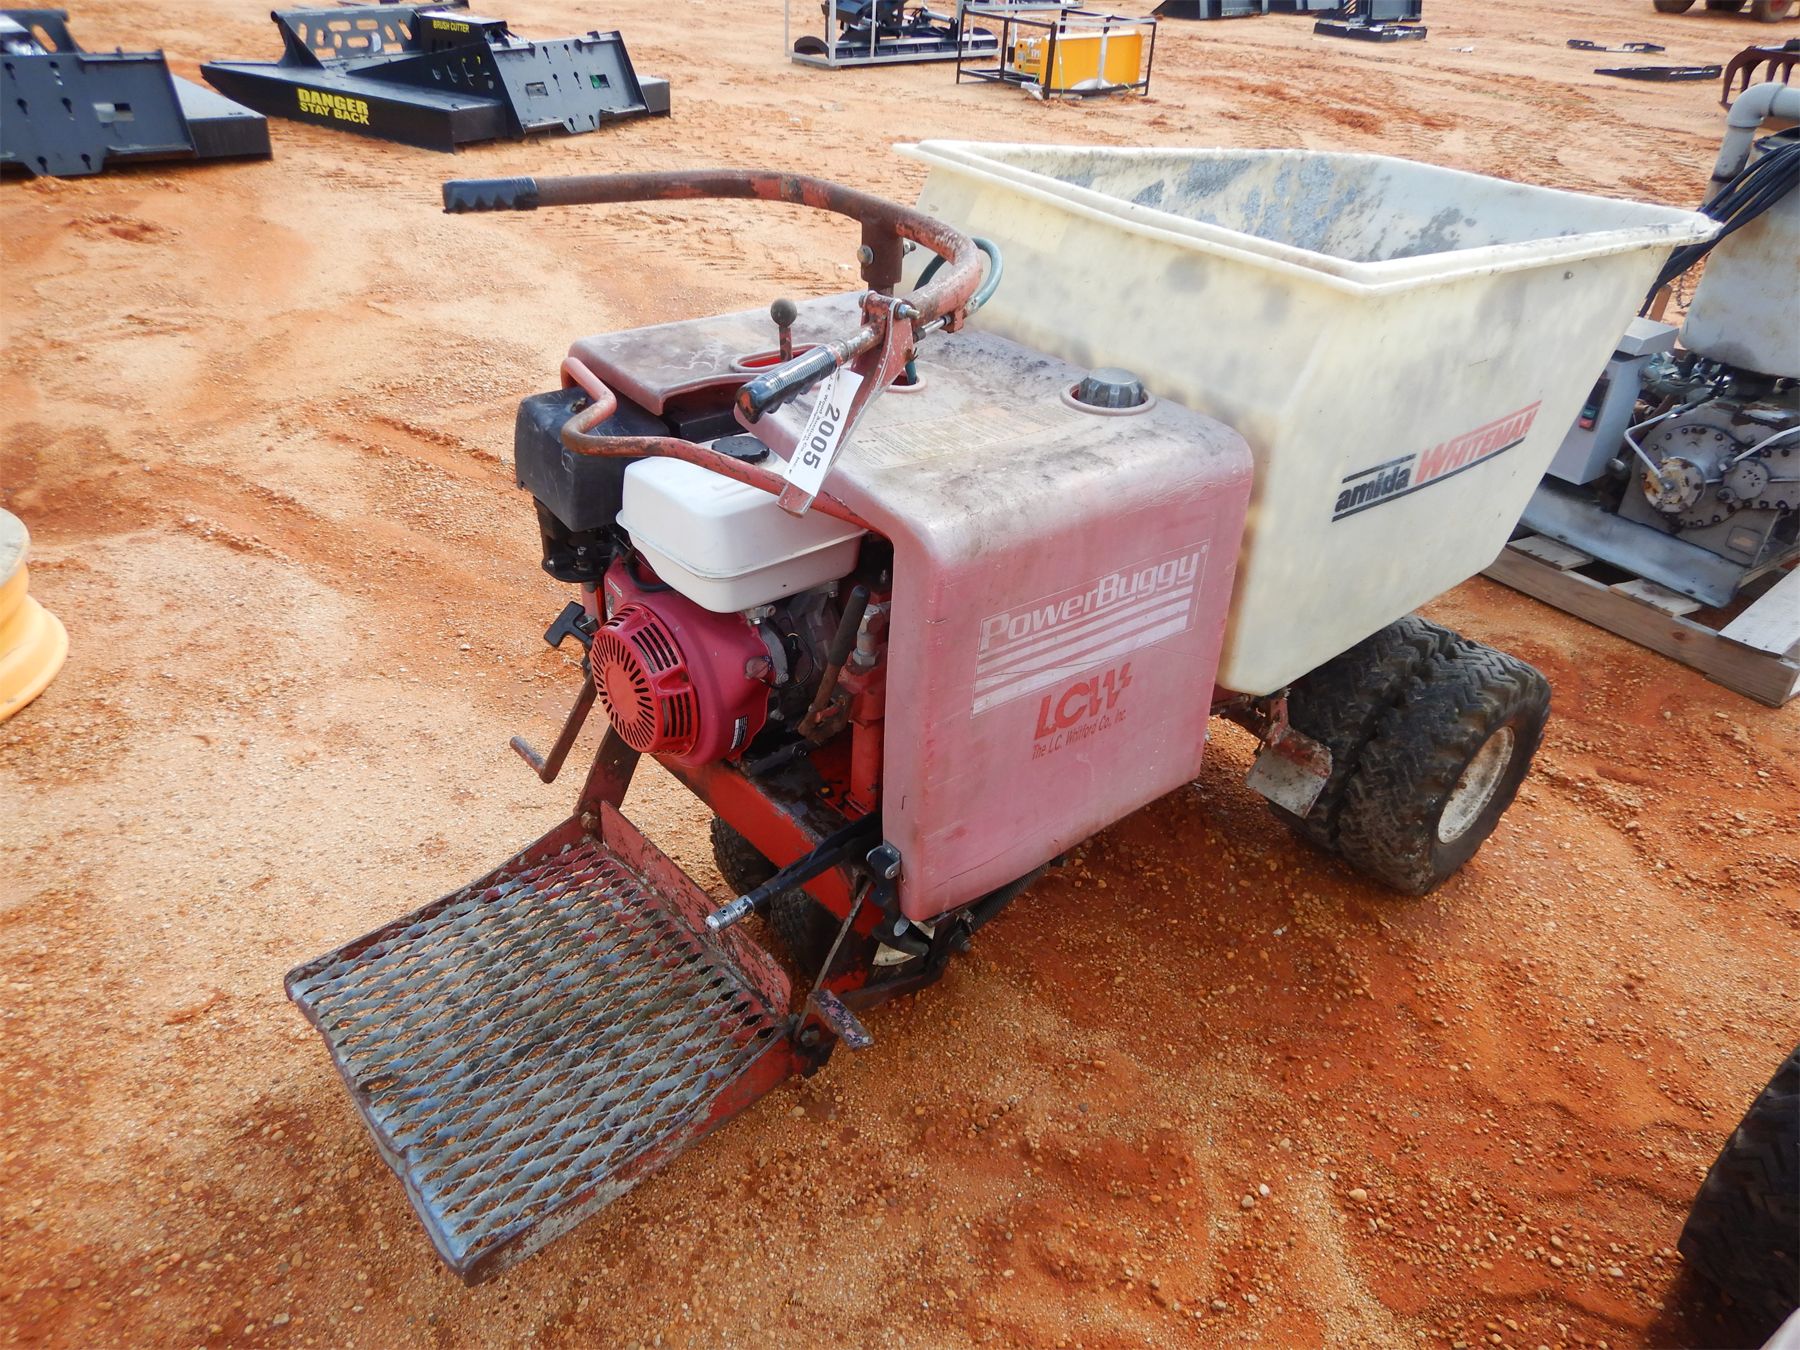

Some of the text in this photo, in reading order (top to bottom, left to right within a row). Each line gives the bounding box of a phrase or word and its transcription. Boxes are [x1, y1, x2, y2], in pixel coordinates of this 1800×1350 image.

[432, 20, 470, 33] BRUSH CUTTER
[298, 88, 369, 115] DANGER
[299, 102, 370, 126] STAY BACK
[803, 403, 840, 469] 2005
[1335, 466, 1411, 512] amida
[1032, 743, 1047, 760] The
